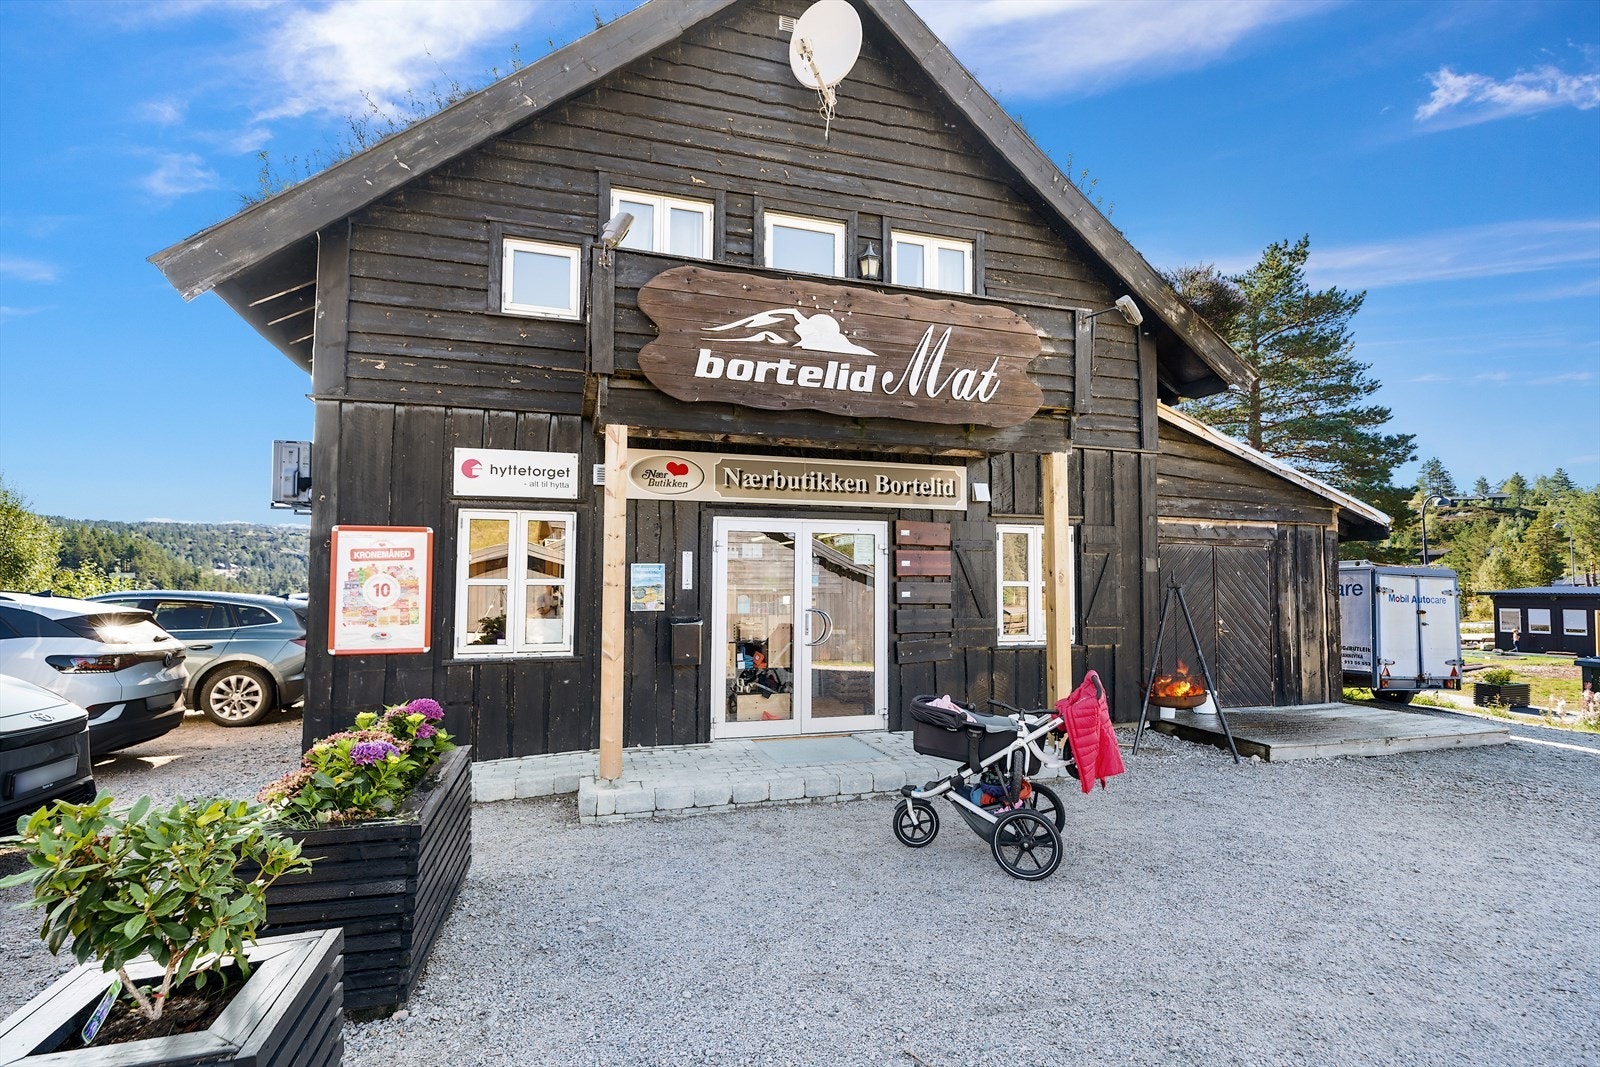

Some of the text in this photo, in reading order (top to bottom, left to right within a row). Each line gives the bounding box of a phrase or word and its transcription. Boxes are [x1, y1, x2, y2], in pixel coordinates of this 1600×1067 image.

[694, 324, 1001, 402] bortelid Mat
[490, 464, 570, 480] hyttetorget
[641, 469, 668, 479] Nær
[550, 481, 569, 490] hytta
[648, 478, 688, 488] Butikken
[722, 467, 956, 497] Nærbutikken Bortelid
[353, 549, 411, 559] KRONEMÅNED
[373, 583, 391, 597] 10
[1388, 594, 1447, 605] Mobil Autocare
